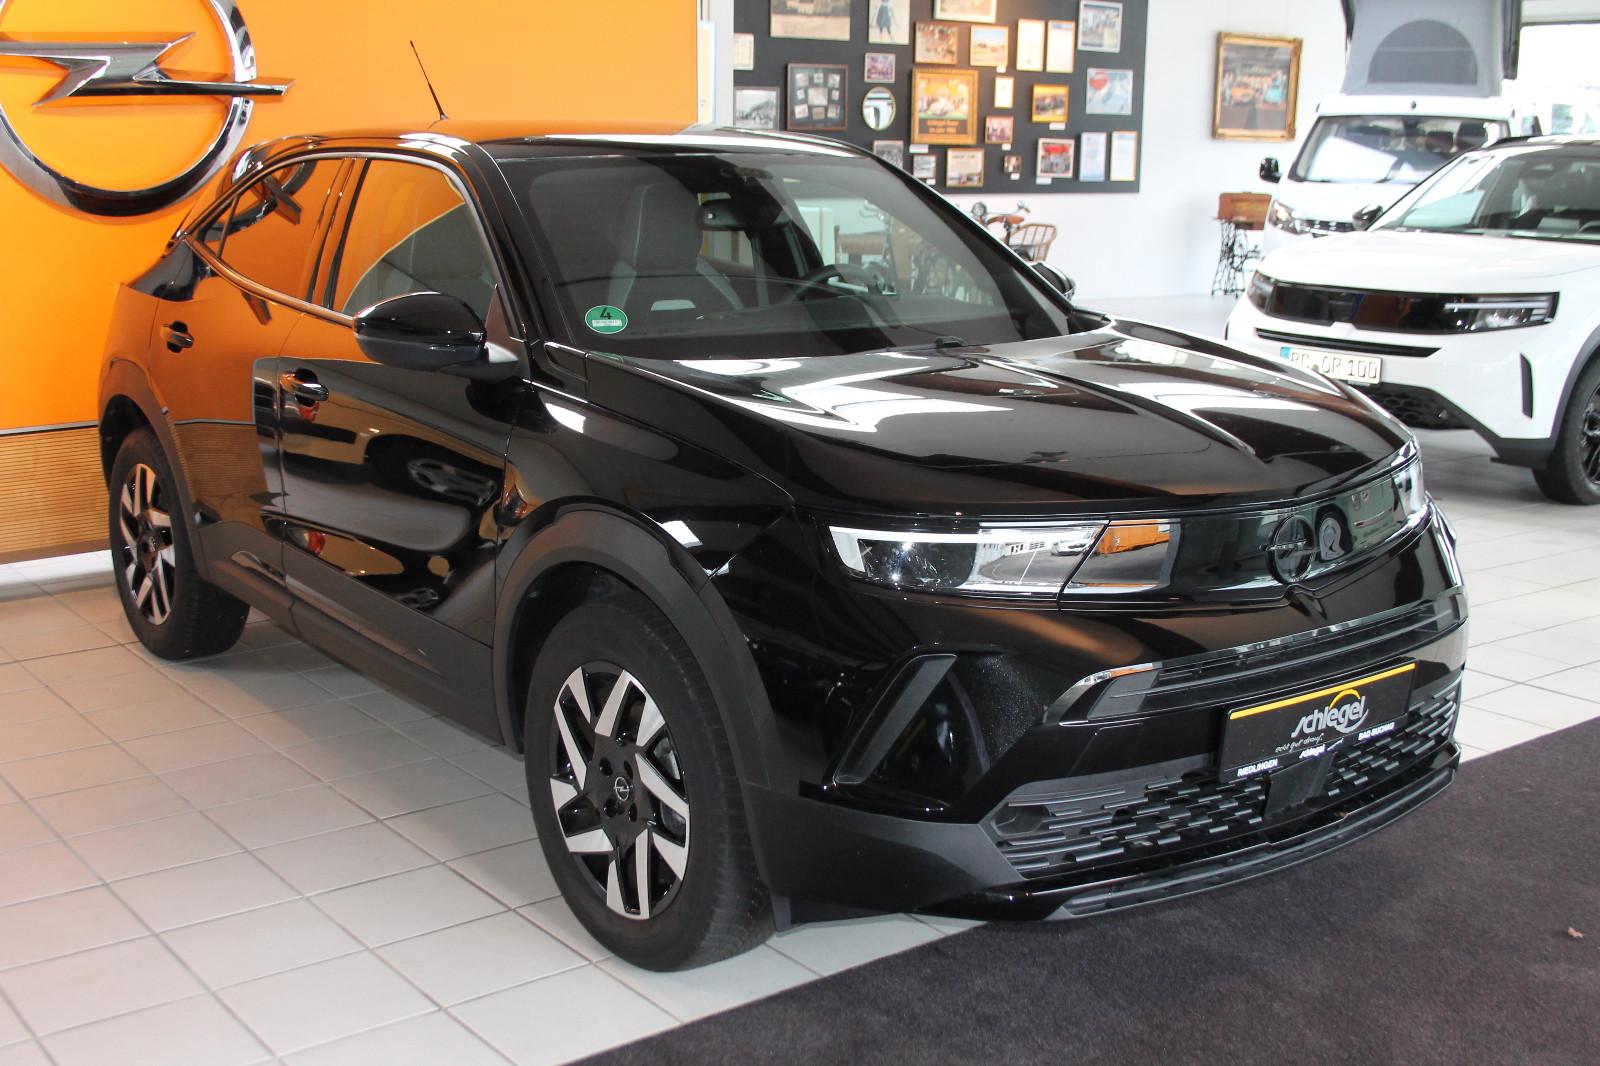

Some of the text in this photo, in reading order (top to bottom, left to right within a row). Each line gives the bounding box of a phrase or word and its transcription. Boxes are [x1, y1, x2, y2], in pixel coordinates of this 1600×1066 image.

[600, 307, 613, 320] 4
[1347, 360, 1377, 379] 100
[1237, 758, 1278, 777] RIEDLINGEN
[1358, 729, 1371, 741] BAD
[1372, 722, 1395, 737] BUCHAU
